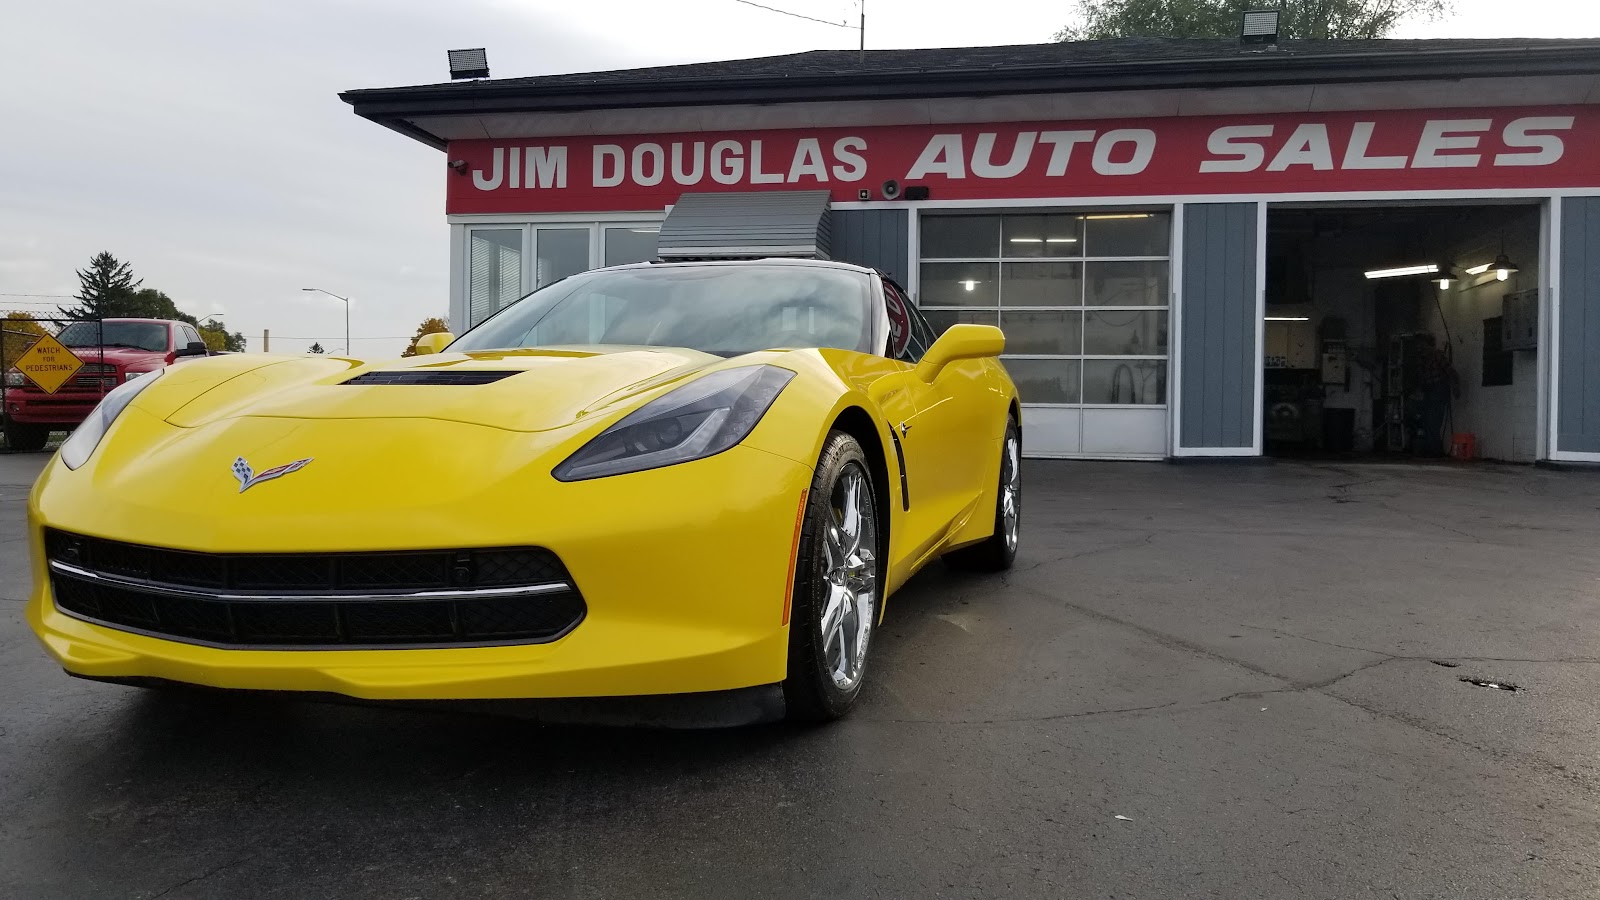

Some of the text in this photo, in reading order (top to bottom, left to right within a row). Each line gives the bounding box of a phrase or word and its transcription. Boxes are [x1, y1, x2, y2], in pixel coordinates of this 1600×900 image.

[473, 117, 1574, 190] JIM DOUGLAS AUTO SALES
[25, 364, 73, 372] PEDESTRIANS
